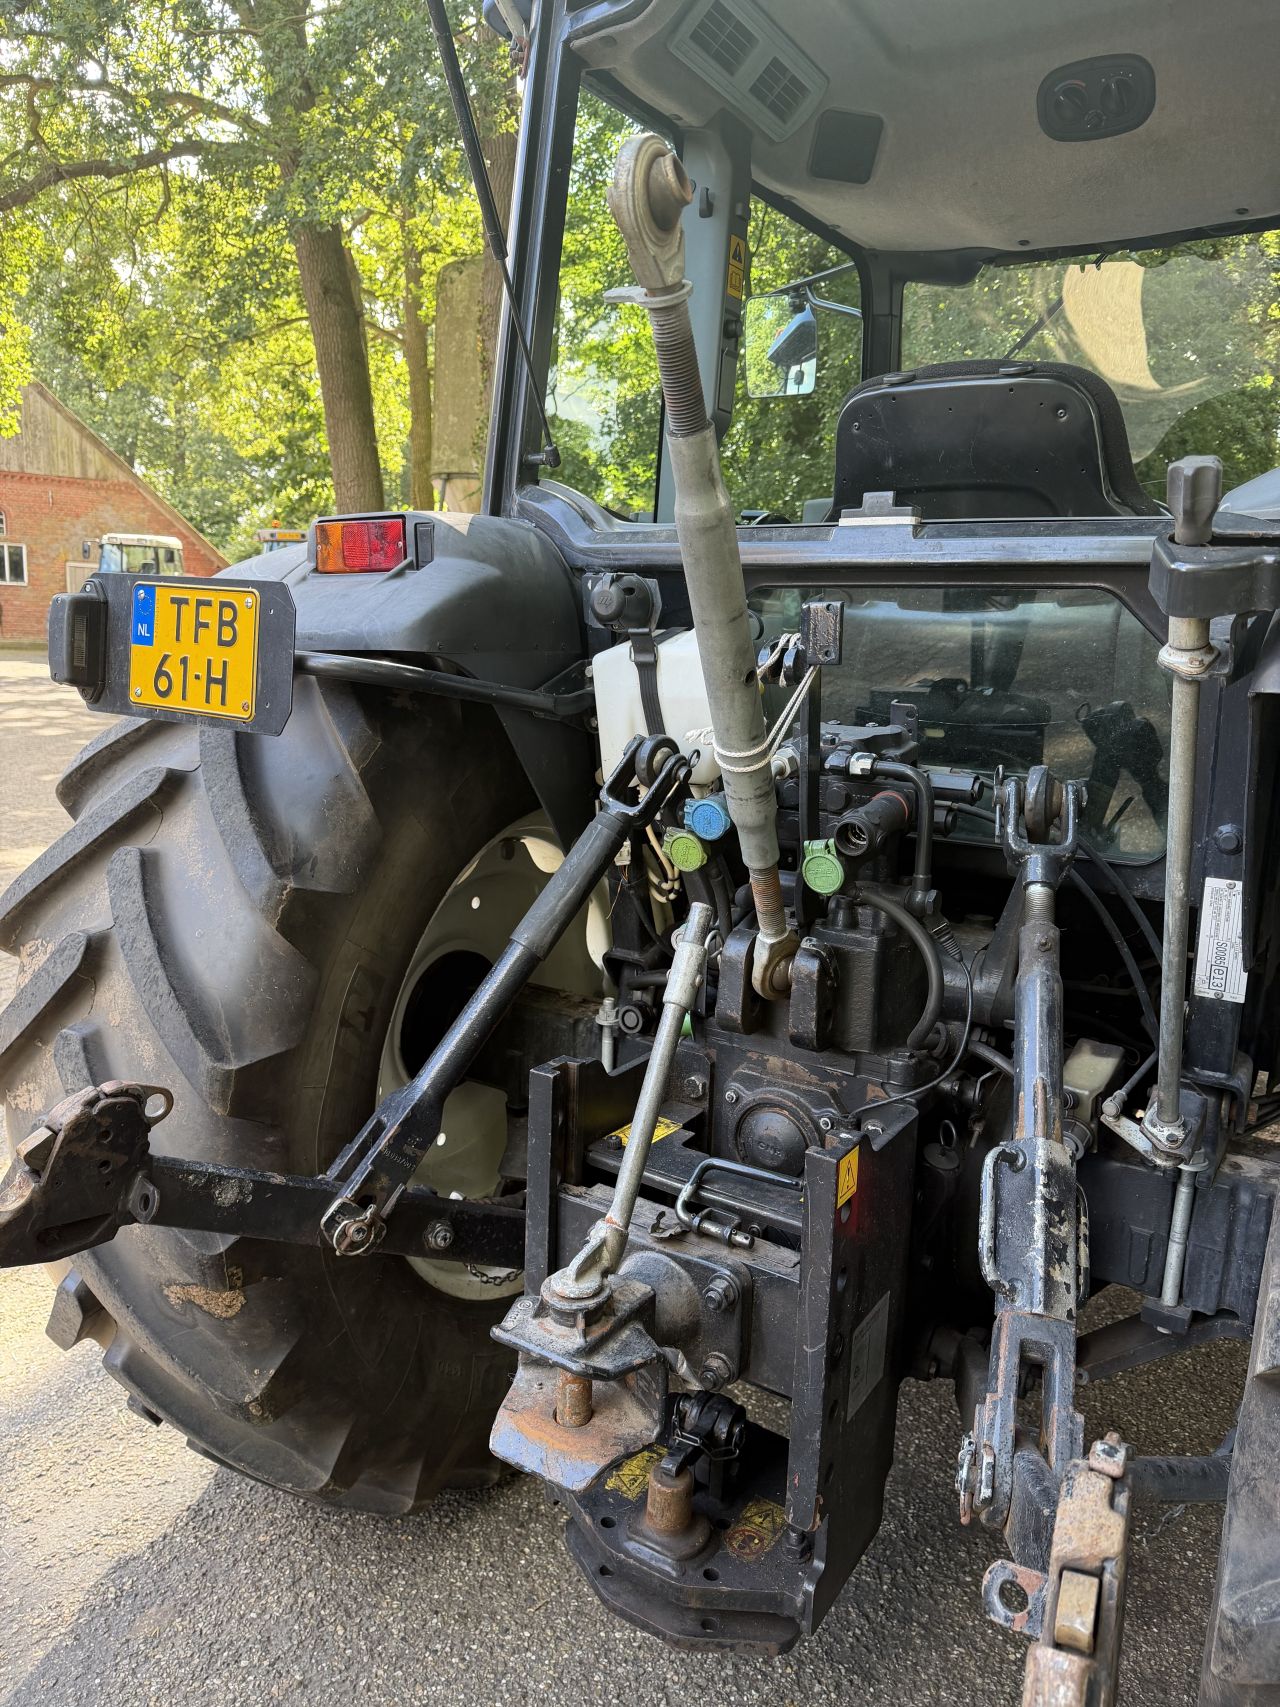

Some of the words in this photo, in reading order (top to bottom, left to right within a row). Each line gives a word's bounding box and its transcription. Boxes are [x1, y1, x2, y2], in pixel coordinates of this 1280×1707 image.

[137, 623, 151, 637] NL
[170, 596, 238, 647] TFB
[1214, 941, 1228, 965] S0085
[1211, 968, 1225, 988] e13
